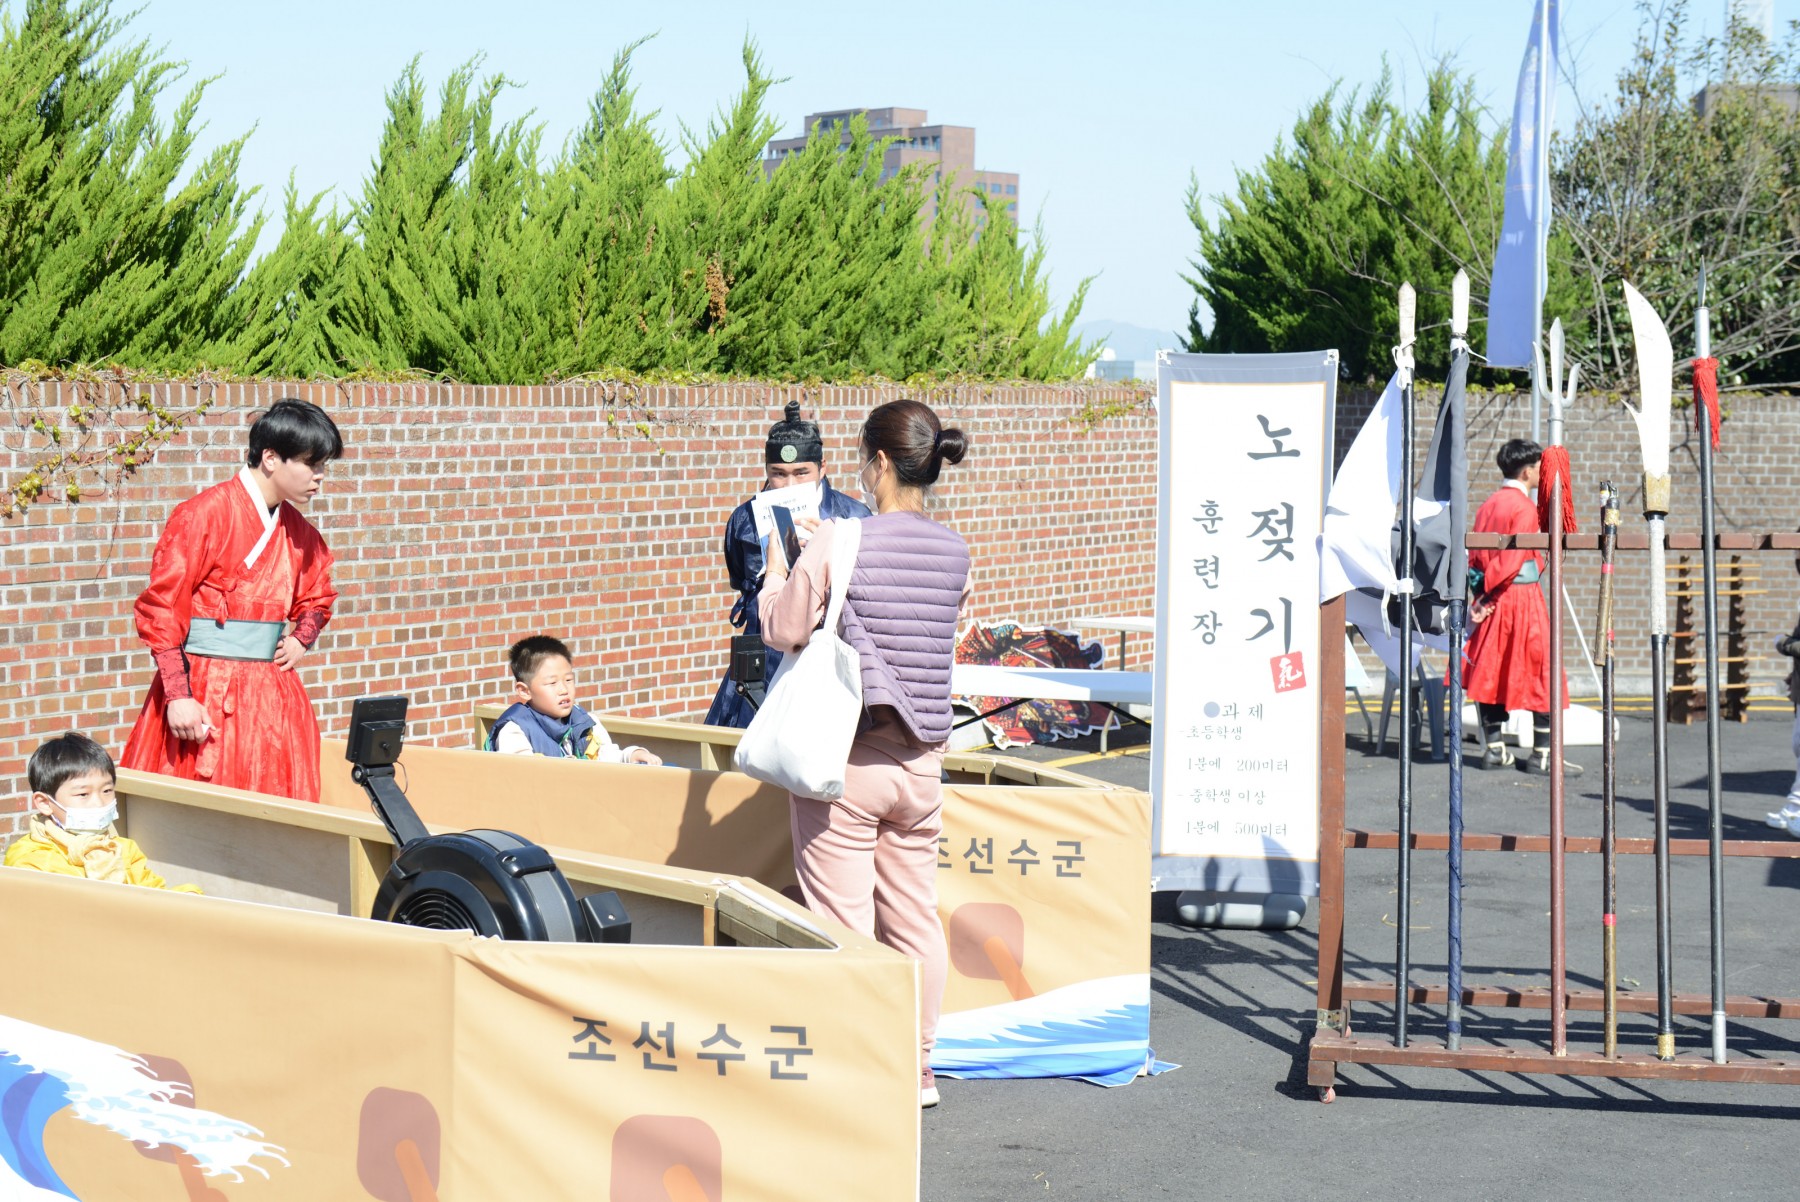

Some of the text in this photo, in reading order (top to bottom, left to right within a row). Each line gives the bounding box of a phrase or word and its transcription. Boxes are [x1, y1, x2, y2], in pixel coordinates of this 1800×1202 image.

[1191, 499, 1224, 645] 훈련장
[1188, 757, 1288, 773] 1분에 200미터
[1187, 820, 1287, 836] 1분에 500미터
[568, 1015, 814, 1081] 조선수군
